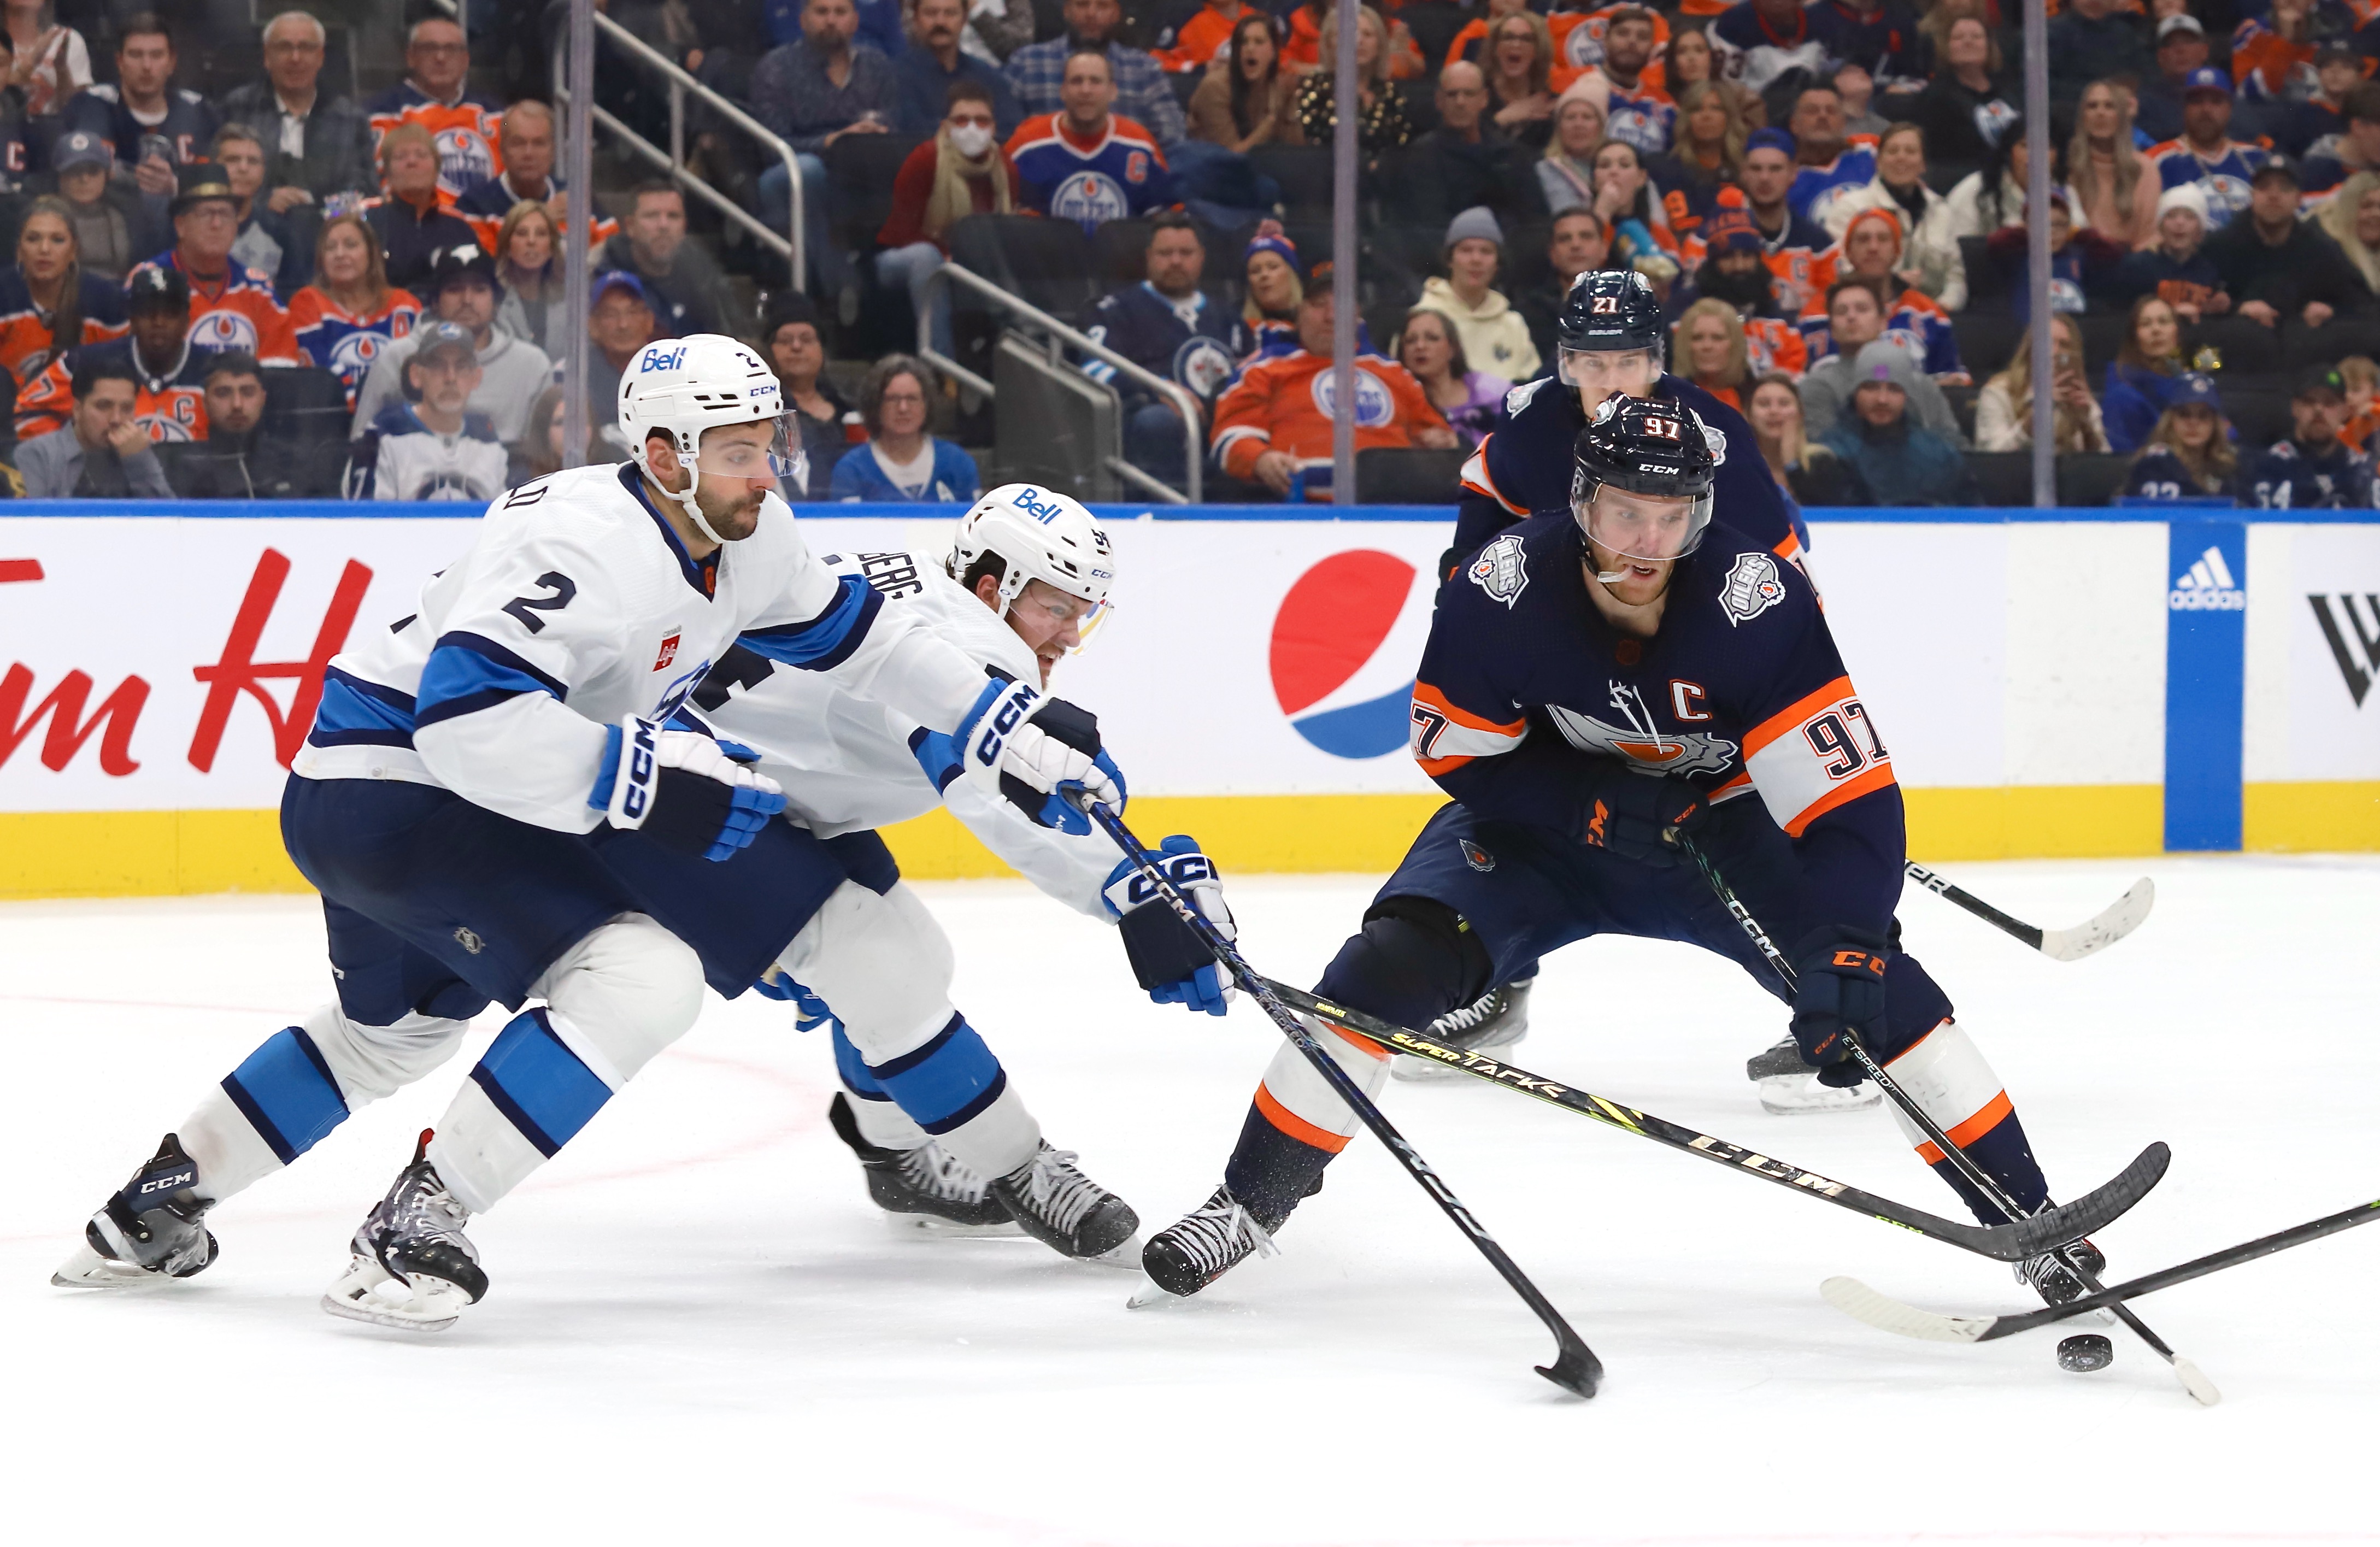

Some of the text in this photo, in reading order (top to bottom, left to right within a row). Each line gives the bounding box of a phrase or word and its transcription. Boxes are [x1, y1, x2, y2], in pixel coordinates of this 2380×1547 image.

[7, 140, 25, 170] C
[1592, 296, 1618, 315] 21
[641, 347, 687, 373] Bell
[175, 396, 195, 424] C
[750, 385, 777, 397] CCM
[1644, 416, 1680, 441] 97
[1639, 463, 1679, 475] CCM
[1012, 488, 1062, 525] Bell
[501, 571, 577, 634] 2
[1730, 557, 1768, 611] OILERS
[2170, 589, 2245, 611] adidas
[1669, 679, 1713, 721] C
[977, 684, 1040, 767] CCM
[1802, 699, 1890, 780] 97
[624, 717, 656, 819] CCM
[1142, 864, 1196, 923] CCM
[1727, 899, 1781, 959] CCM
[1255, 992, 1306, 1049] JETSPEED
[1391, 1033, 1461, 1062] SUPER
[1464, 1051, 1567, 1098] TACKS
[140, 1172, 191, 1194] CCM
[1688, 1135, 1849, 1197] CCM
